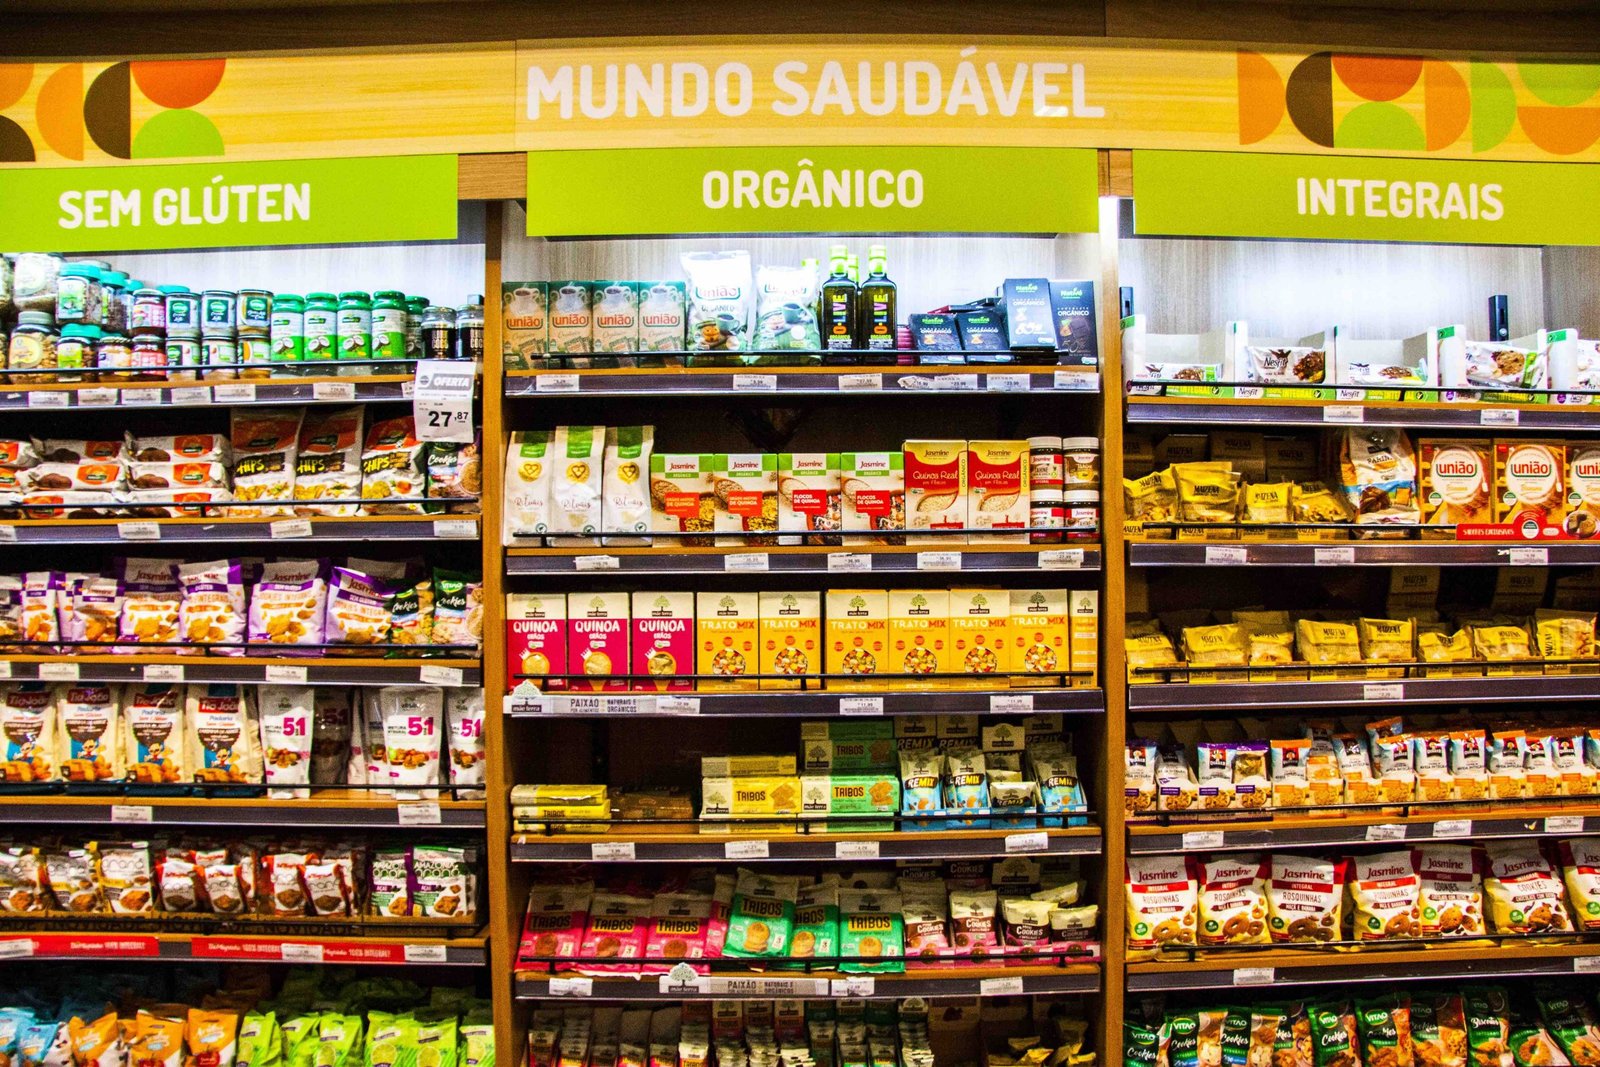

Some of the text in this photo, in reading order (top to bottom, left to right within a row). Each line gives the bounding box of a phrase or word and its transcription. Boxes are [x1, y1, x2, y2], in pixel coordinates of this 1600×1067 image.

[526, 46, 1105, 120] MUNDO SAUDÁVEL
[702, 159, 924, 209] ORGÂNICO
[58, 175, 311, 229] SEM GLÚTEN
[1296, 177, 1504, 221] INTEGRAIS
[509, 317, 541, 328] união
[555, 314, 586, 326] união
[600, 314, 631, 326] união
[646, 314, 676, 325] união
[433, 376, 470, 387] OFERTA
[924, 450, 950, 458] Jasmine
[987, 450, 1012, 458] Jasmine
[364, 457, 390, 472] CHIPS
[797, 460, 823, 468] Jasmine
[860, 460, 886, 468] Jasmine
[1438, 461, 1474, 474] união
[1513, 461, 1549, 474] união
[913, 471, 958, 480] Quinoa Real
[975, 471, 1020, 480] Quinoa Real
[513, 620, 558, 633] QUINOA
[575, 620, 620, 633] QUINOA
[639, 620, 686, 632] QUINOA
[570, 698, 599, 708] PAIXÃO
[908, 778, 935, 787] REMIX
[955, 775, 980, 786] REMIX
[1048, 777, 1073, 786] REMIX
[736, 791, 766, 802] TRIBOS
[834, 786, 864, 797] TRIBOS
[1428, 858, 1464, 870] Jasmine
[1504, 860, 1542, 873] Jasmine
[1138, 870, 1178, 882] Jasmine
[1214, 868, 1252, 880] Jasmine
[1282, 868, 1325, 880] Jasmine
[1366, 866, 1404, 880] Jasmine
[1434, 882, 1458, 892] COOKIES
[1518, 881, 1547, 892] COOKIES
[1142, 894, 1180, 904] ROSQUINHAS
[1214, 890, 1246, 901] ROSQUINHAS
[1282, 892, 1322, 903] ROSQUINHAS
[742, 900, 783, 916] TRIBOS
[532, 914, 571, 928] TRIBOS
[594, 918, 634, 931] TRIBOS
[658, 918, 698, 932] TRIBOS
[850, 916, 890, 929] TRIBOS
[728, 980, 757, 990] PAIXÃO
[1171, 1038, 1196, 1050] Cookies
[1220, 1033, 1250, 1046] Cookies
[1322, 1030, 1348, 1046] Cookies
[1127, 1047, 1156, 1060] Cookies
